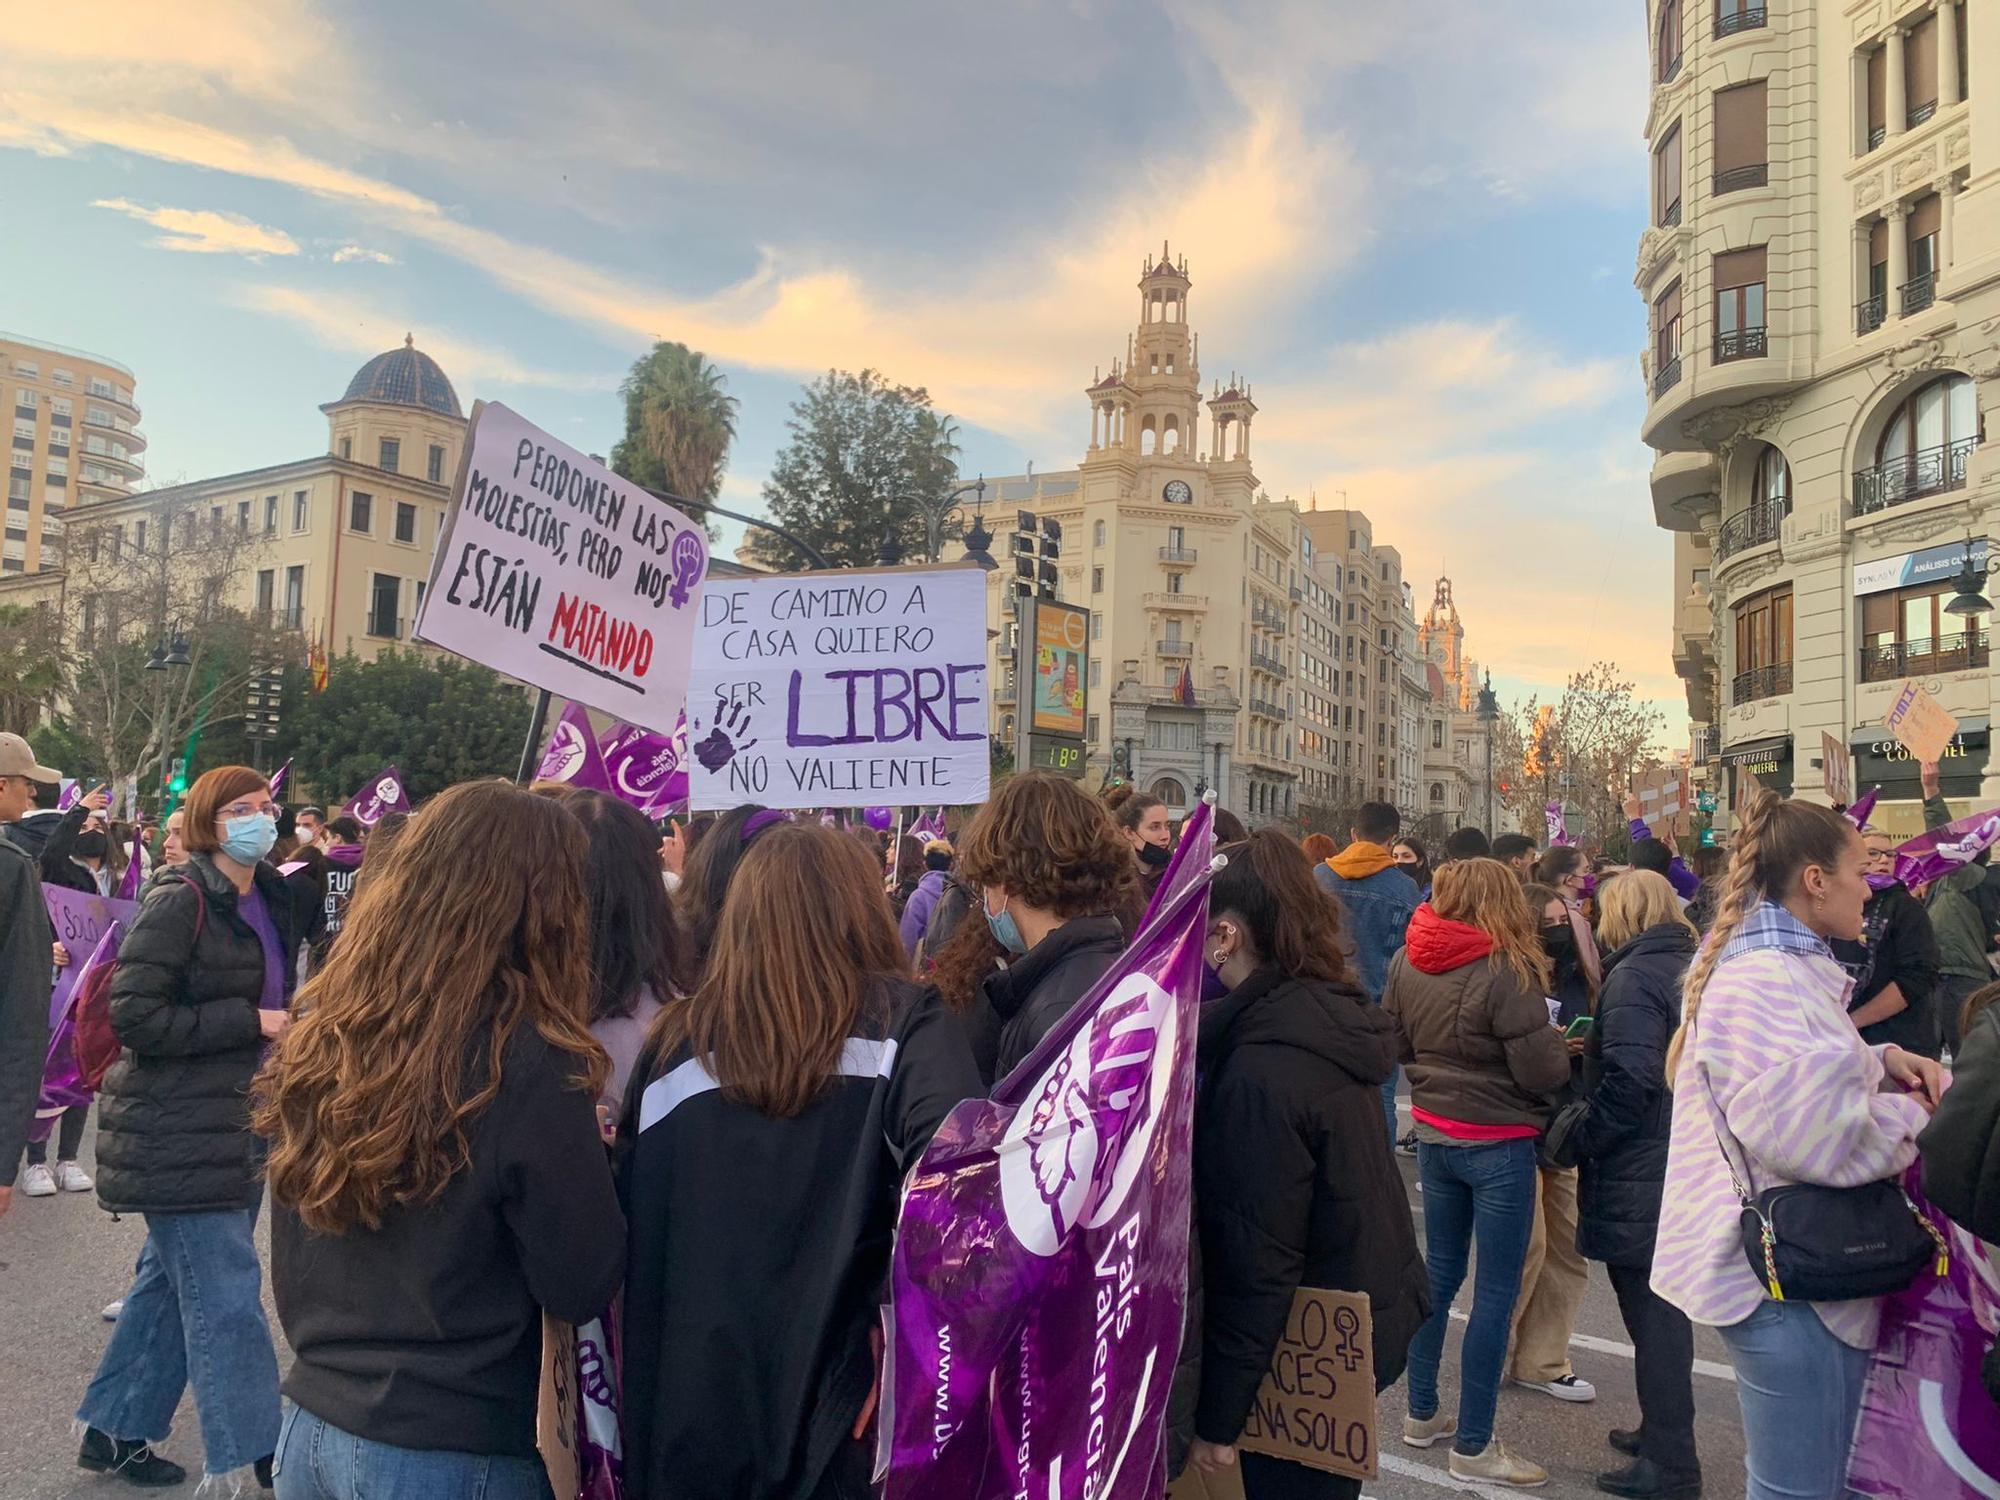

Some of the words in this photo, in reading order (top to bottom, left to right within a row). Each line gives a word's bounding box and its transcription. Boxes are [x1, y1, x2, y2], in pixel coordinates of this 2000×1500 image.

[514, 438, 626, 531] PERDONEN
[632, 505, 675, 555] LAS
[577, 527, 622, 580] PERO
[634, 561, 672, 608] NOS
[1914, 558, 1950, 574] ANÁLISIS
[447, 542, 541, 634] ESTÁN
[548, 591, 653, 677] MATANDO
[704, 592, 749, 627] DE
[771, 585, 887, 620] CAMINO
[903, 585, 925, 614] A
[722, 630, 797, 660] CASA
[815, 625, 934, 655] QUIERO
[714, 681, 766, 708] SER
[787, 664, 987, 747] LIBRE
[730, 756, 768, 793] NO
[786, 757, 952, 791] VALIENTE
